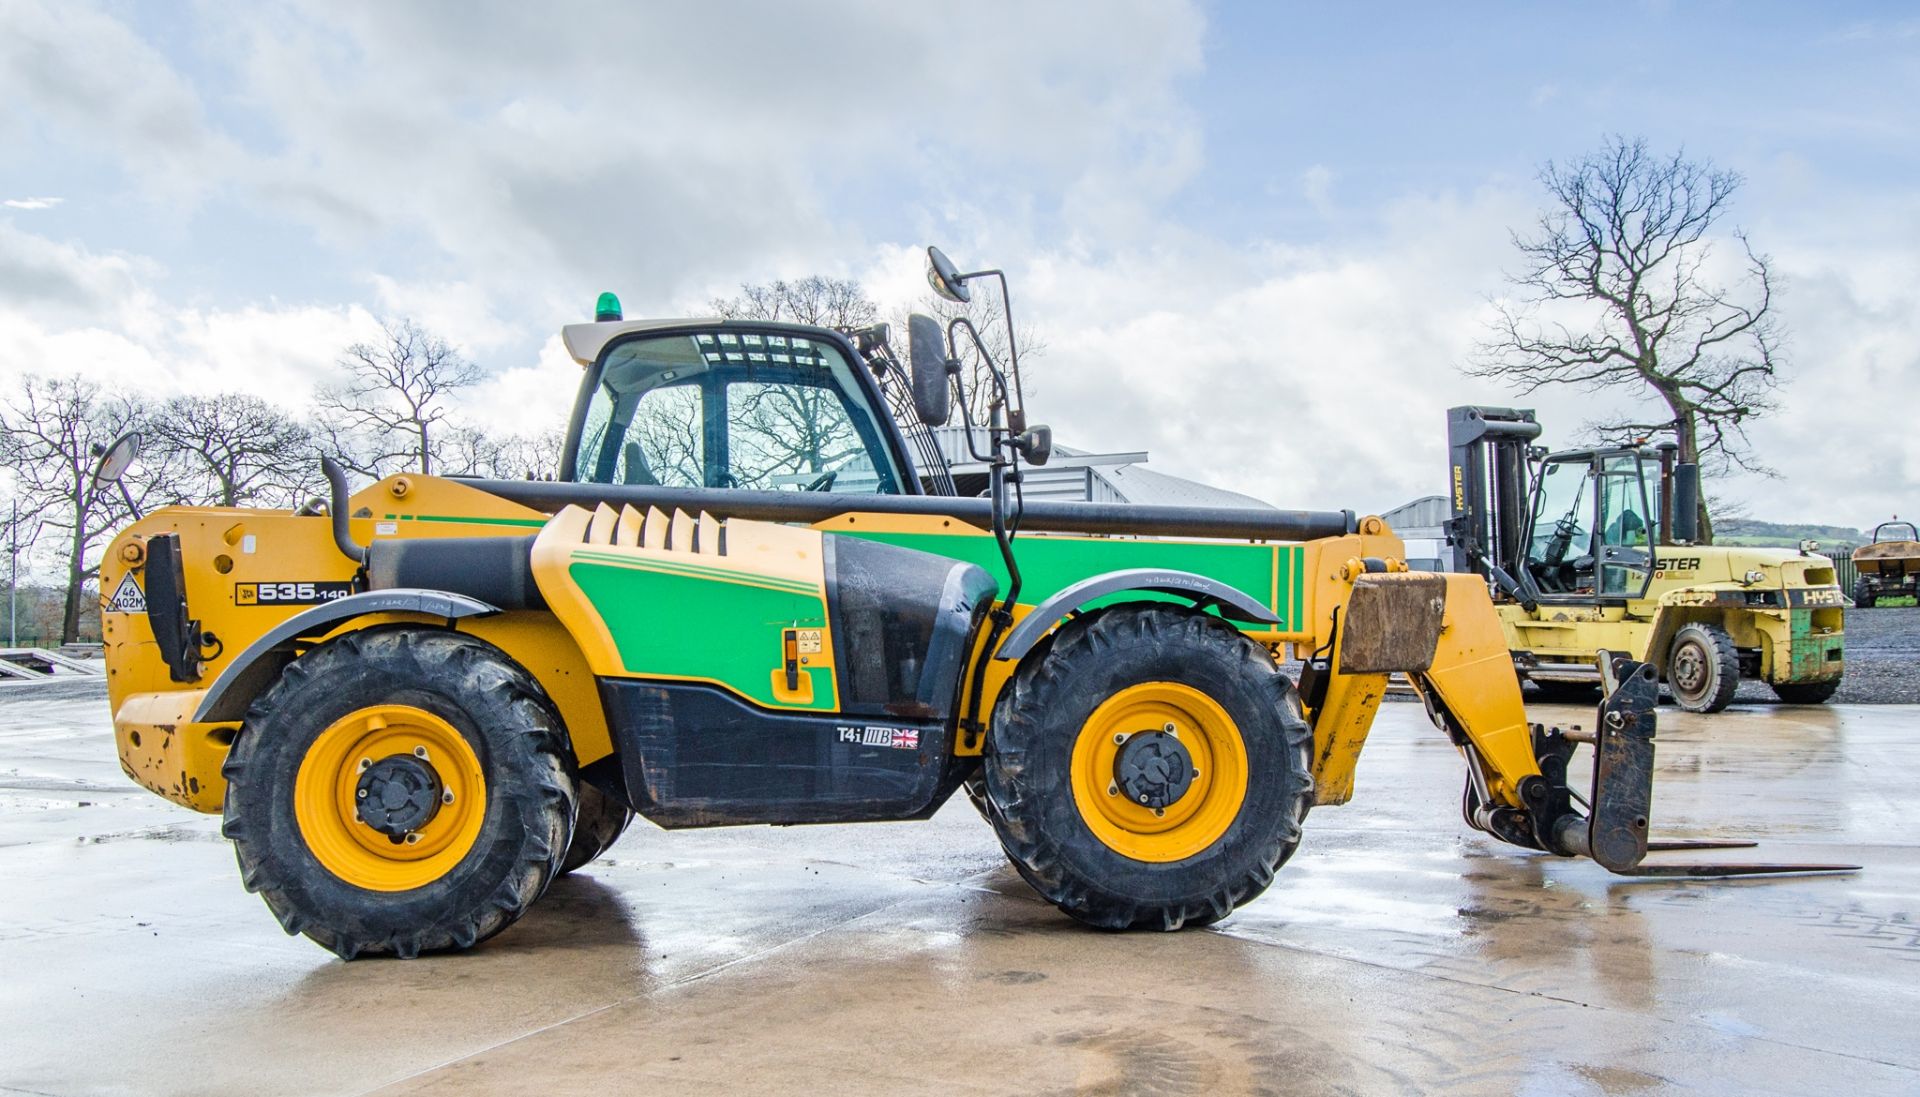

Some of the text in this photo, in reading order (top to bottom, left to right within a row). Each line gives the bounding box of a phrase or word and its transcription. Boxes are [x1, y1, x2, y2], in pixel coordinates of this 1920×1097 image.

[1454, 465, 1463, 510] HYSTER
[1656, 558, 1701, 570] STER
[122, 587, 136, 597] 46
[258, 583, 348, 600] 535-140
[116, 598, 143, 608] A02M
[837, 727, 861, 742] T4i
